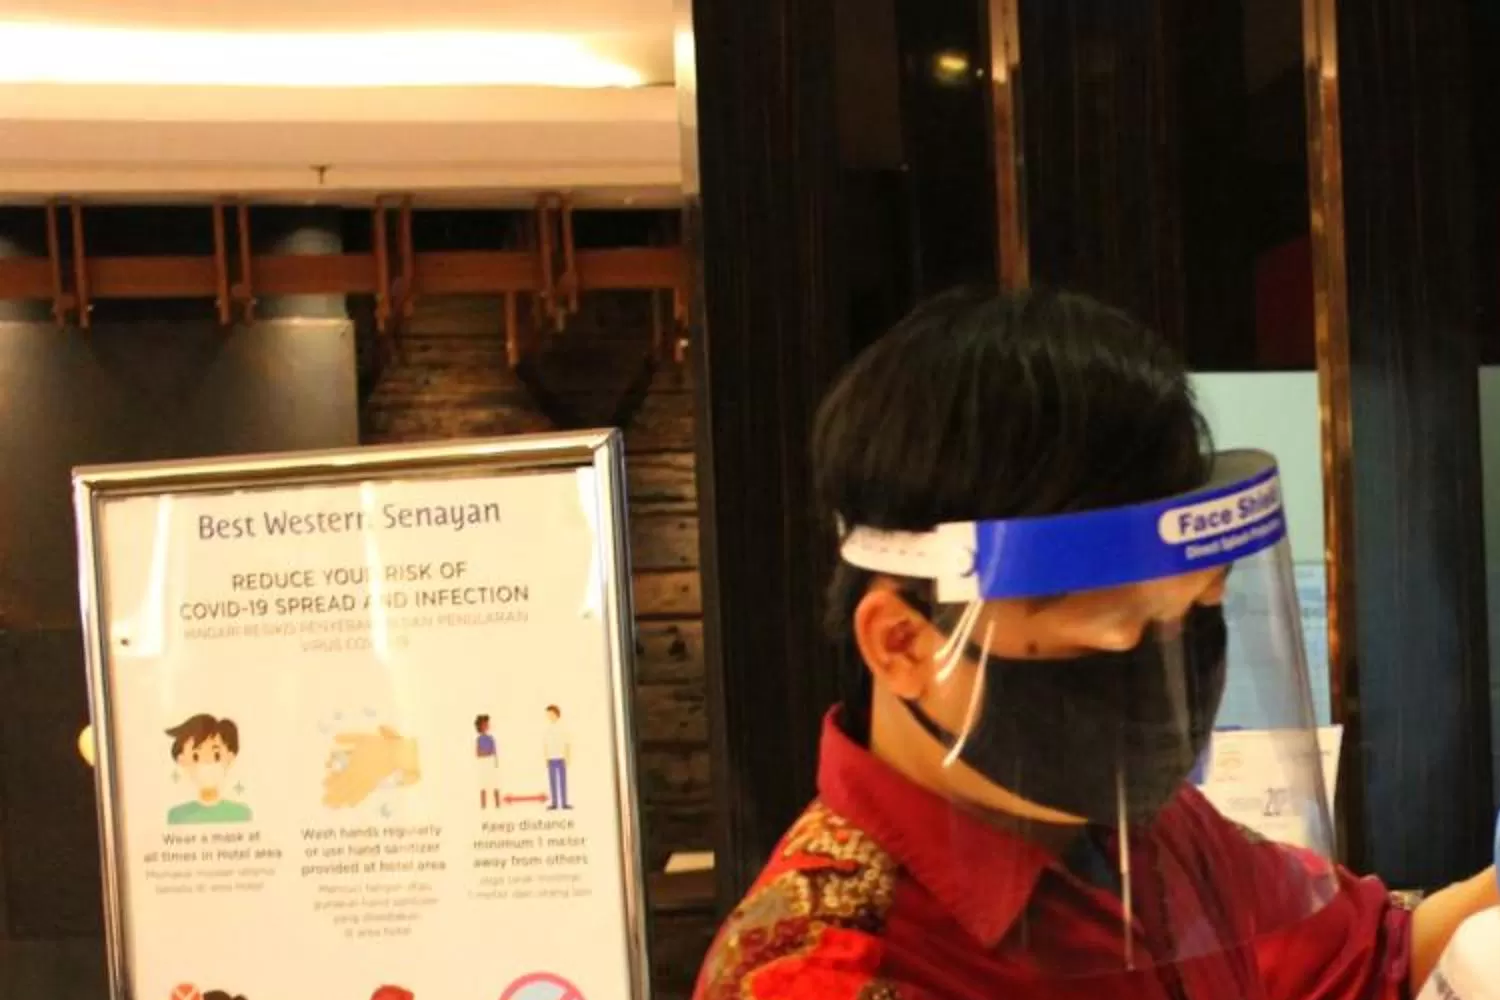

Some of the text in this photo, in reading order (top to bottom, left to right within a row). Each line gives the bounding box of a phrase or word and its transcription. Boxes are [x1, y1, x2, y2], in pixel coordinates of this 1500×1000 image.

[198, 513, 258, 541] Best
[381, 501, 501, 532] Senayan
[1178, 509, 1234, 536] Face
[231, 560, 468, 592] REDUCE YOU RISK OF
[179, 599, 269, 621] COVID-19
[274, 594, 357, 616] SPREAD
[415, 583, 530, 608] INFECTION
[300, 827, 338, 842] Wash
[339, 825, 380, 840] hands
[519, 818, 576, 832] distance
[161, 831, 198, 846] Wear
[247, 829, 261, 844] at
[473, 838, 535, 850] minimum
[304, 847, 319, 859] or
[321, 846, 345, 859] use
[347, 843, 381, 858] hand
[301, 860, 360, 878] provided
[363, 861, 377, 874] at
[416, 860, 447, 873] area
[473, 853, 589, 871] away from others
